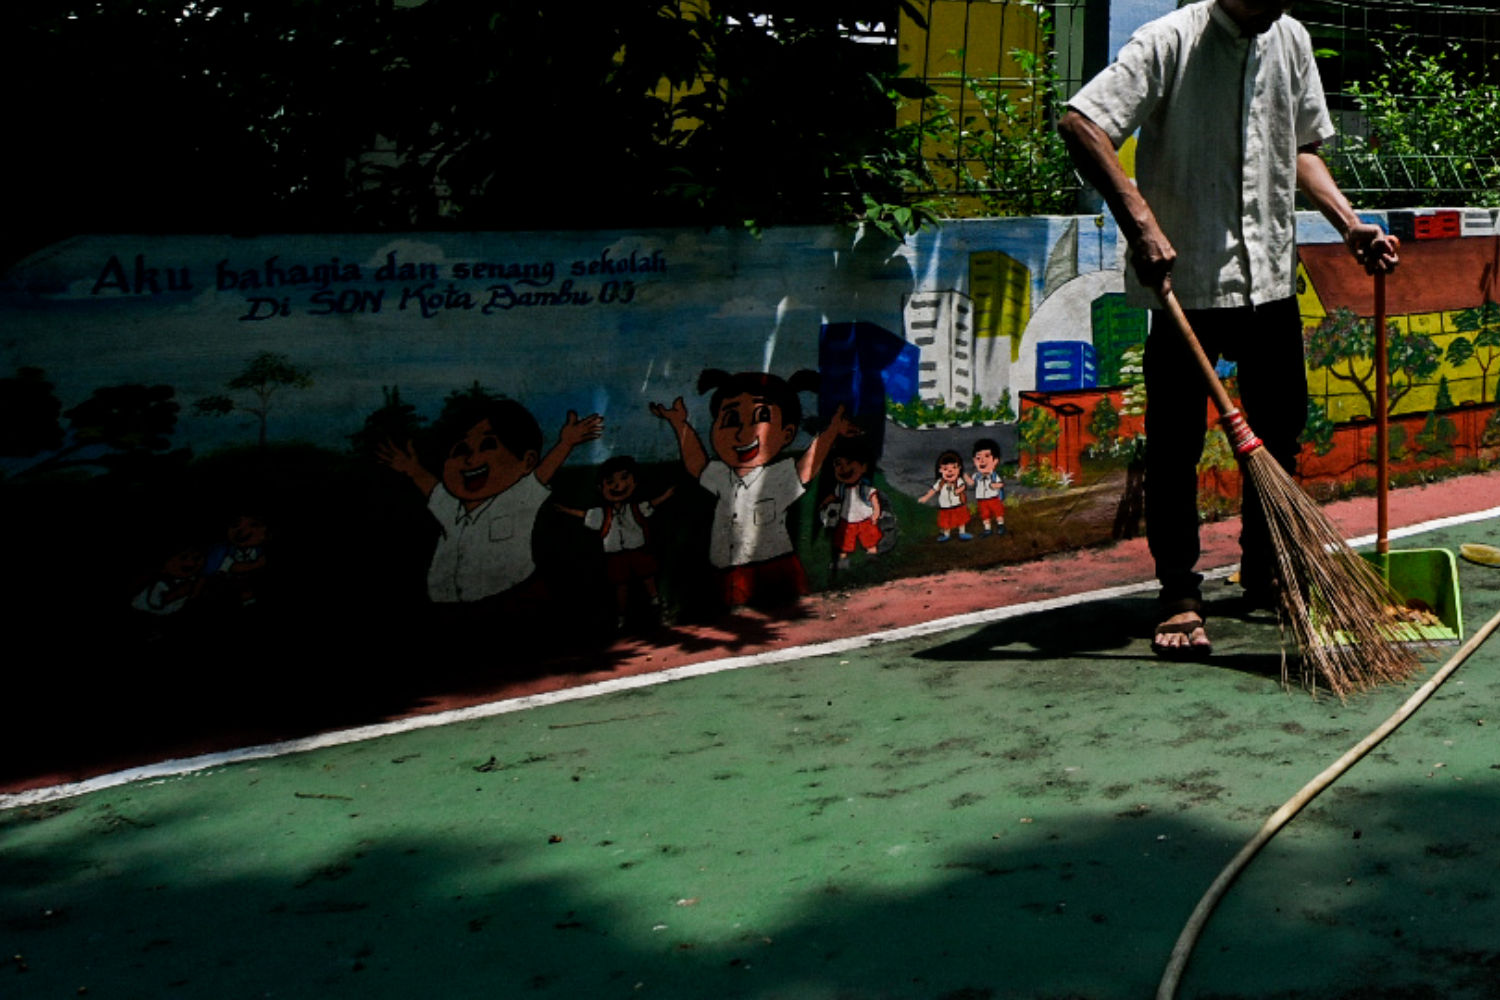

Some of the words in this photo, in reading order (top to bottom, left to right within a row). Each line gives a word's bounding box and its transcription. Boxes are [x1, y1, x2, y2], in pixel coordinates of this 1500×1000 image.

[92, 254, 193, 295] Aku
[216, 255, 363, 291] bahagia
[375, 250, 438, 282] dan
[452, 262, 554, 286] senang
[571, 249, 666, 277] sekolah
[238, 297, 291, 321] Di
[308, 289, 384, 315] SDN
[399, 283, 474, 319] Kota
[481, 279, 592, 315] Bambu
